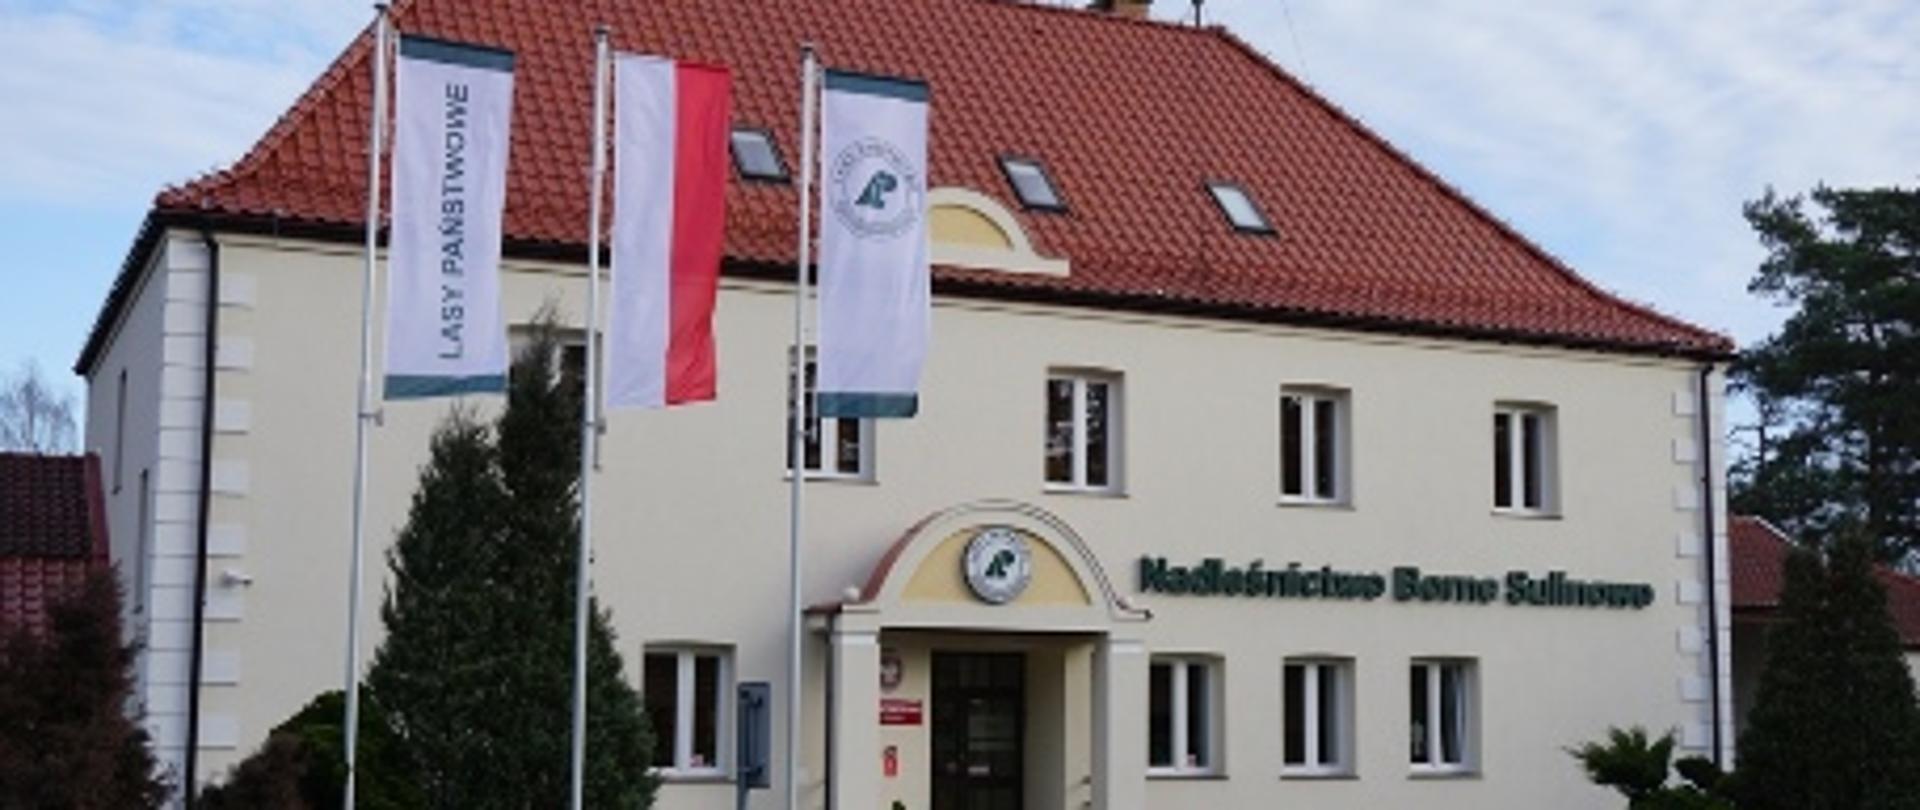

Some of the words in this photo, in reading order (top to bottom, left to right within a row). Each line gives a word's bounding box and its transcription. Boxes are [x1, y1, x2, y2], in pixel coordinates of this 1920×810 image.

[437, 83, 469, 277] PAŃSTWOWE
[438, 285, 464, 360] LASY
[1138, 556, 1386, 600] Nadleśnictwo
[1393, 566, 1498, 605] Borne
[1506, 570, 1655, 609] Sulinowo
